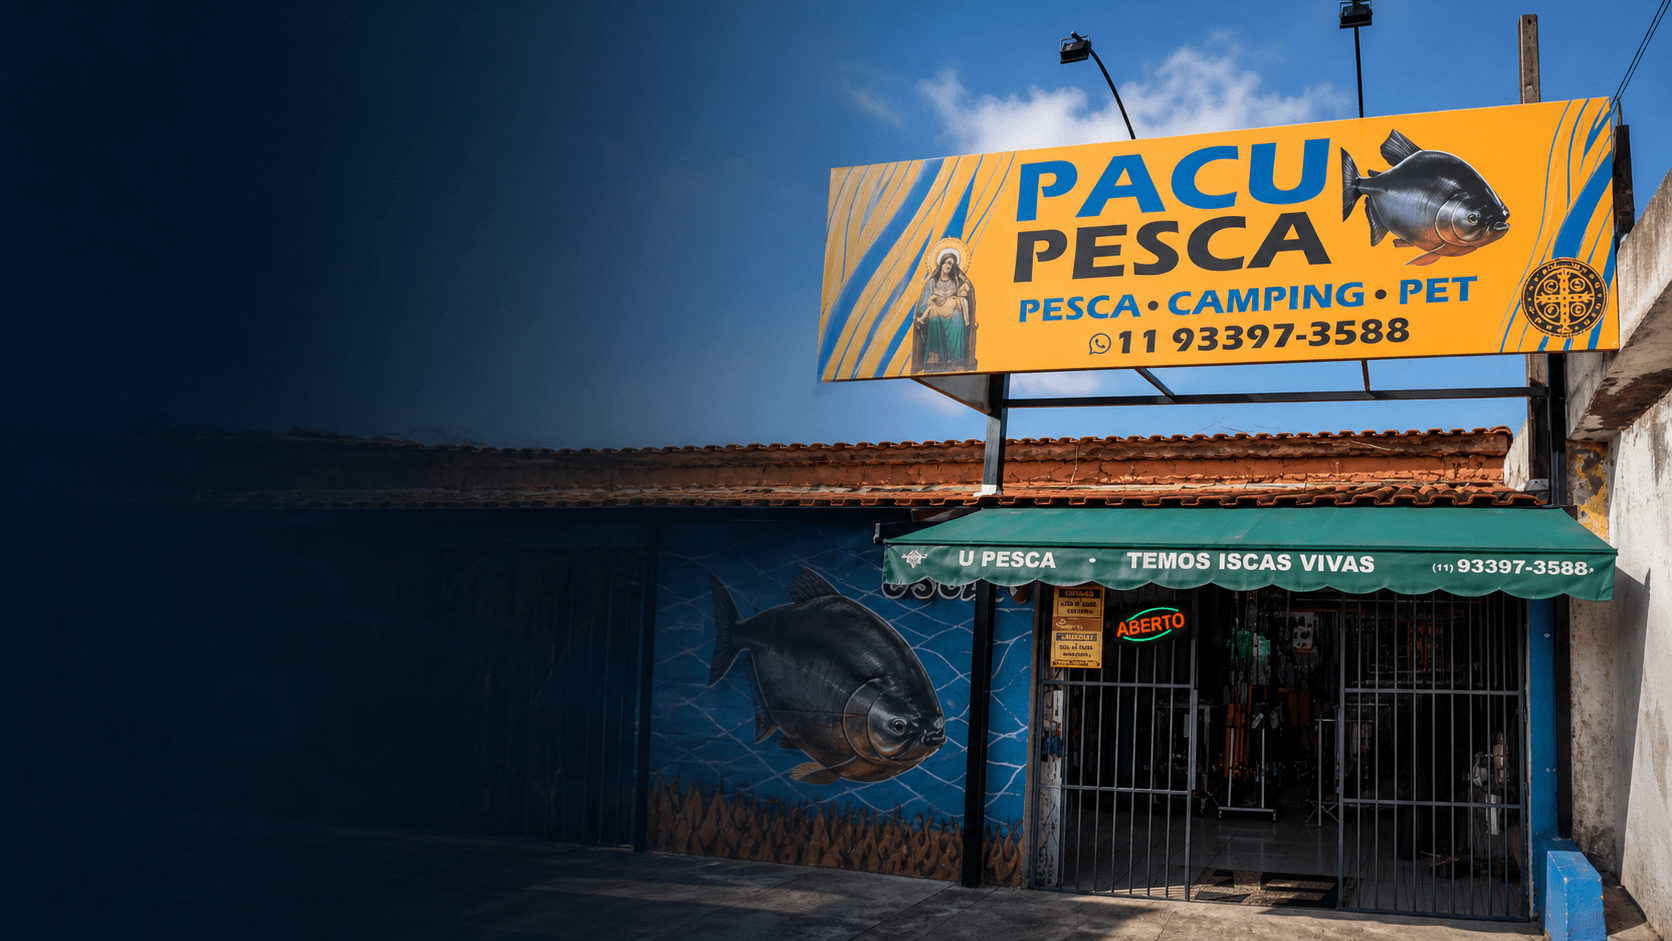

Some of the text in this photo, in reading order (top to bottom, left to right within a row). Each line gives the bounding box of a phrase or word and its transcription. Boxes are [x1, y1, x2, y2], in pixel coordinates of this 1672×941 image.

[1016, 138, 1330, 222] PACU
[1013, 212, 1332, 283] PESCA
[1019, 276, 1478, 322] PESCA CAMPING PET
[1118, 317, 1410, 354] 11 93397-3588
[958, 550, 1056, 569] U PESCA
[1127, 552, 1375, 573] TEMOS ISCAS VIVAS
[1432, 559, 1588, 576] (11) 93397-3588
[1117, 612, 1185, 638] ABERTO
